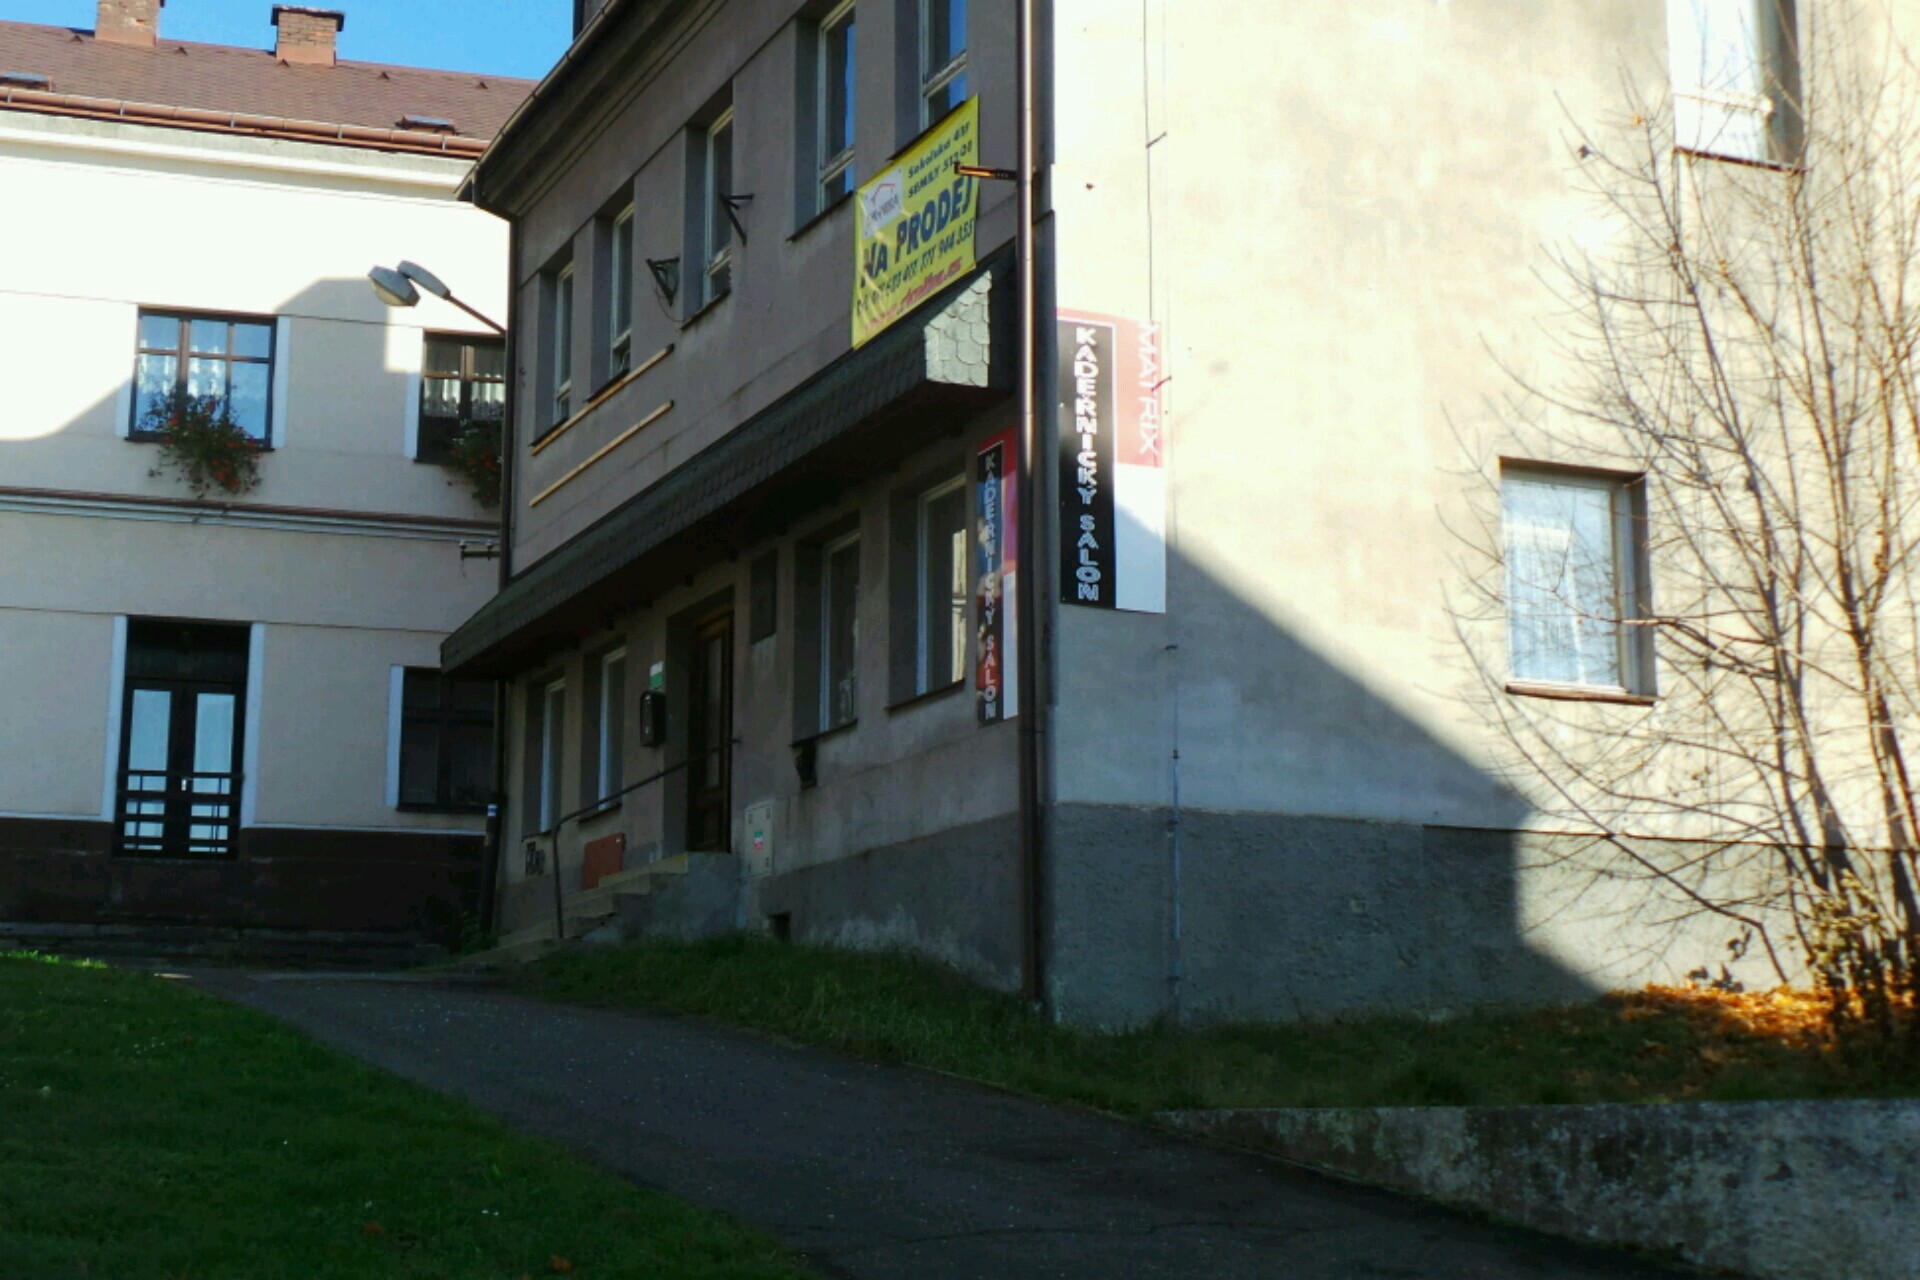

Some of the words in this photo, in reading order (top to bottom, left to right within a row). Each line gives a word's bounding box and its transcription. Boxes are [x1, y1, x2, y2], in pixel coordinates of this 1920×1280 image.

[861, 241, 888, 289] NA
[894, 173, 973, 265] PRODEJ
[1137, 320, 1160, 456] MATRIX
[1076, 513, 1101, 601] SALON
[984, 635, 997, 720] SALON
